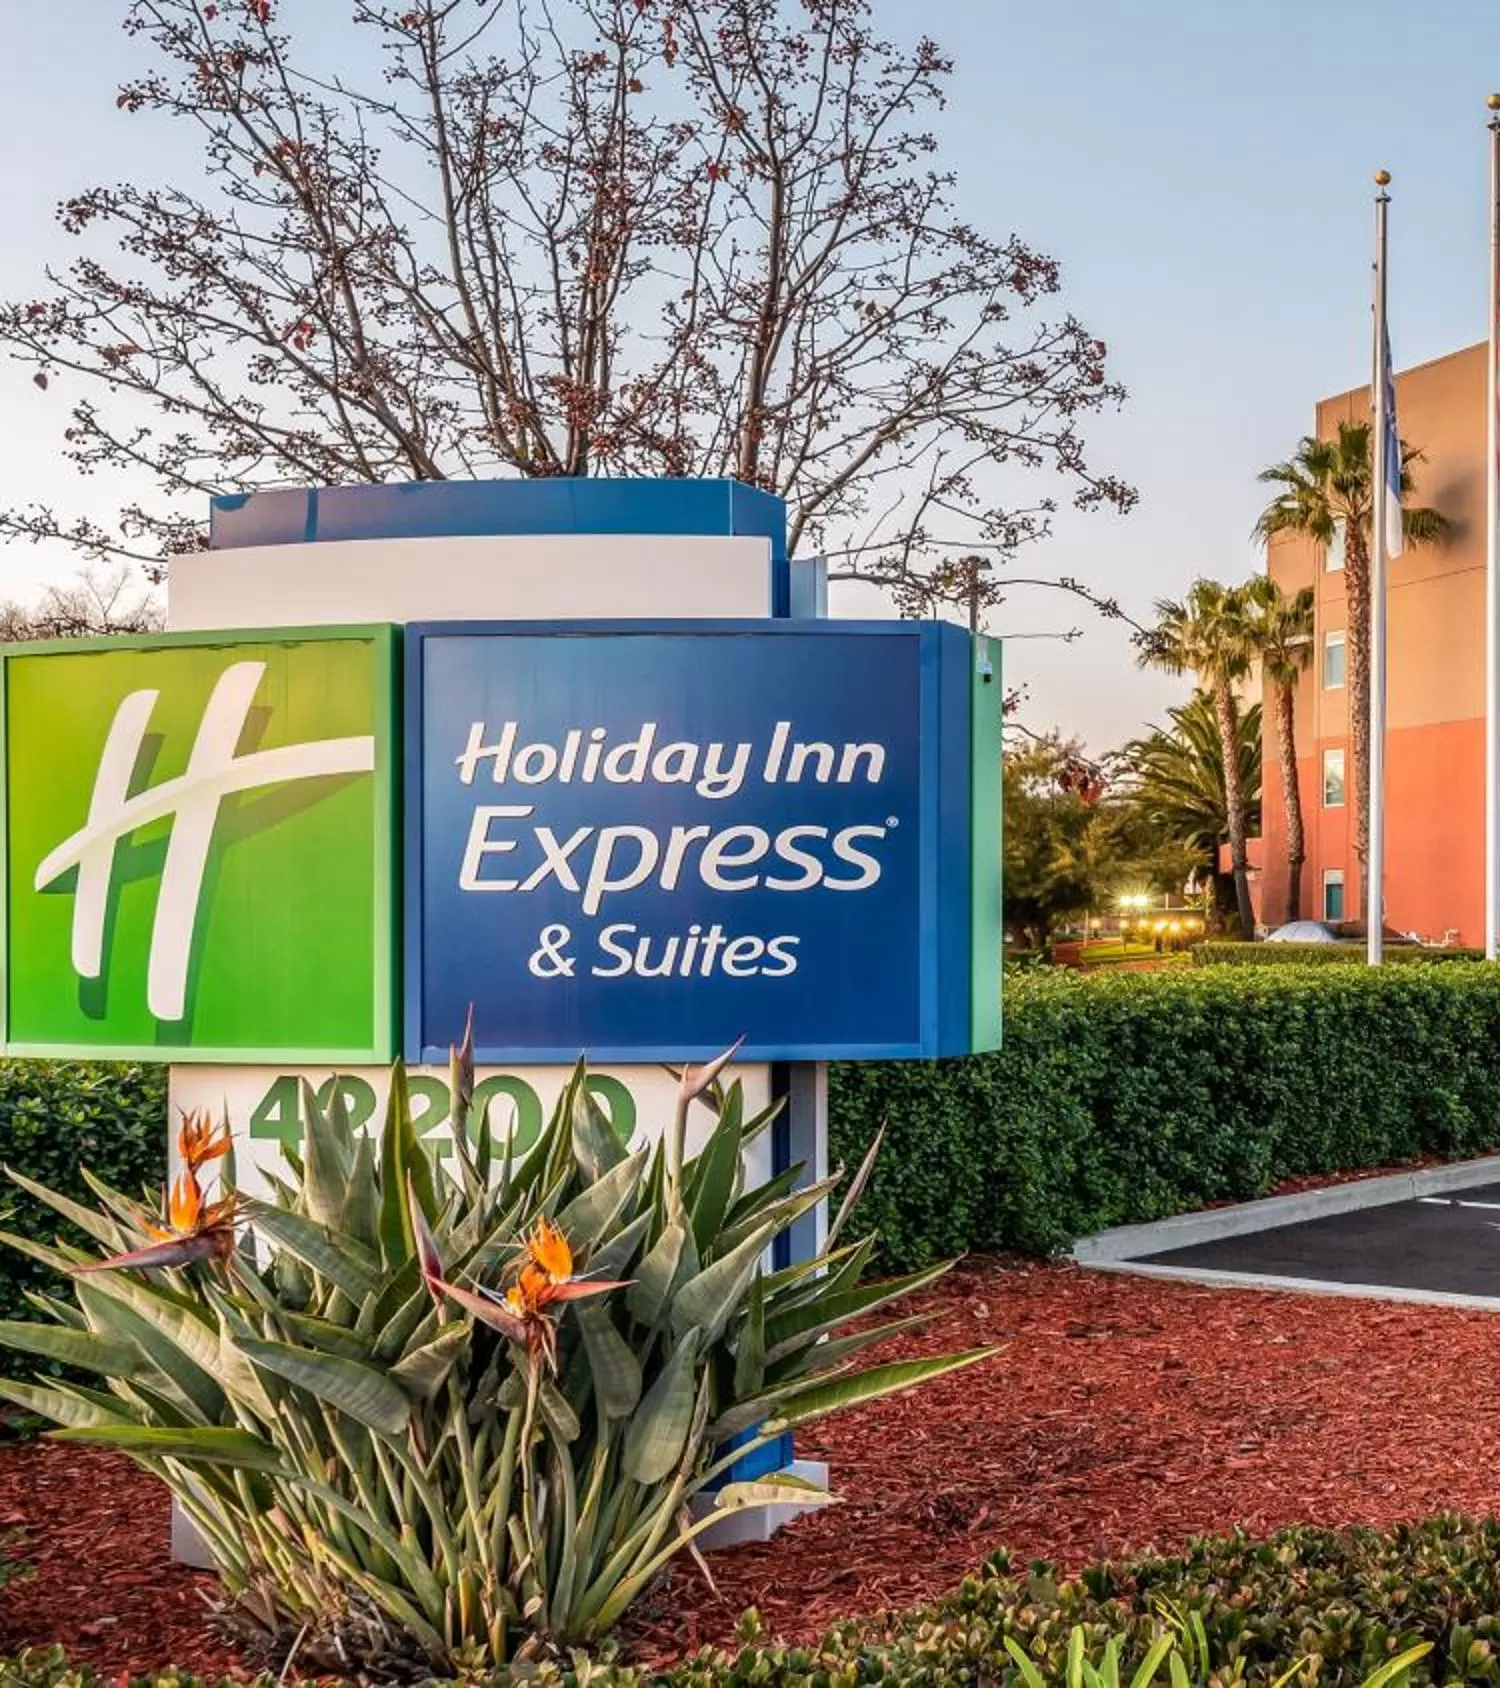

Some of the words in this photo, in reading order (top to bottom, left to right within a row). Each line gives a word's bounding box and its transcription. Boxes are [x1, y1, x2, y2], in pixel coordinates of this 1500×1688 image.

[454, 721, 752, 799] Holiday
[763, 721, 885, 783] Inn
[528, 924, 576, 978] &
[592, 923, 800, 978] Suites
